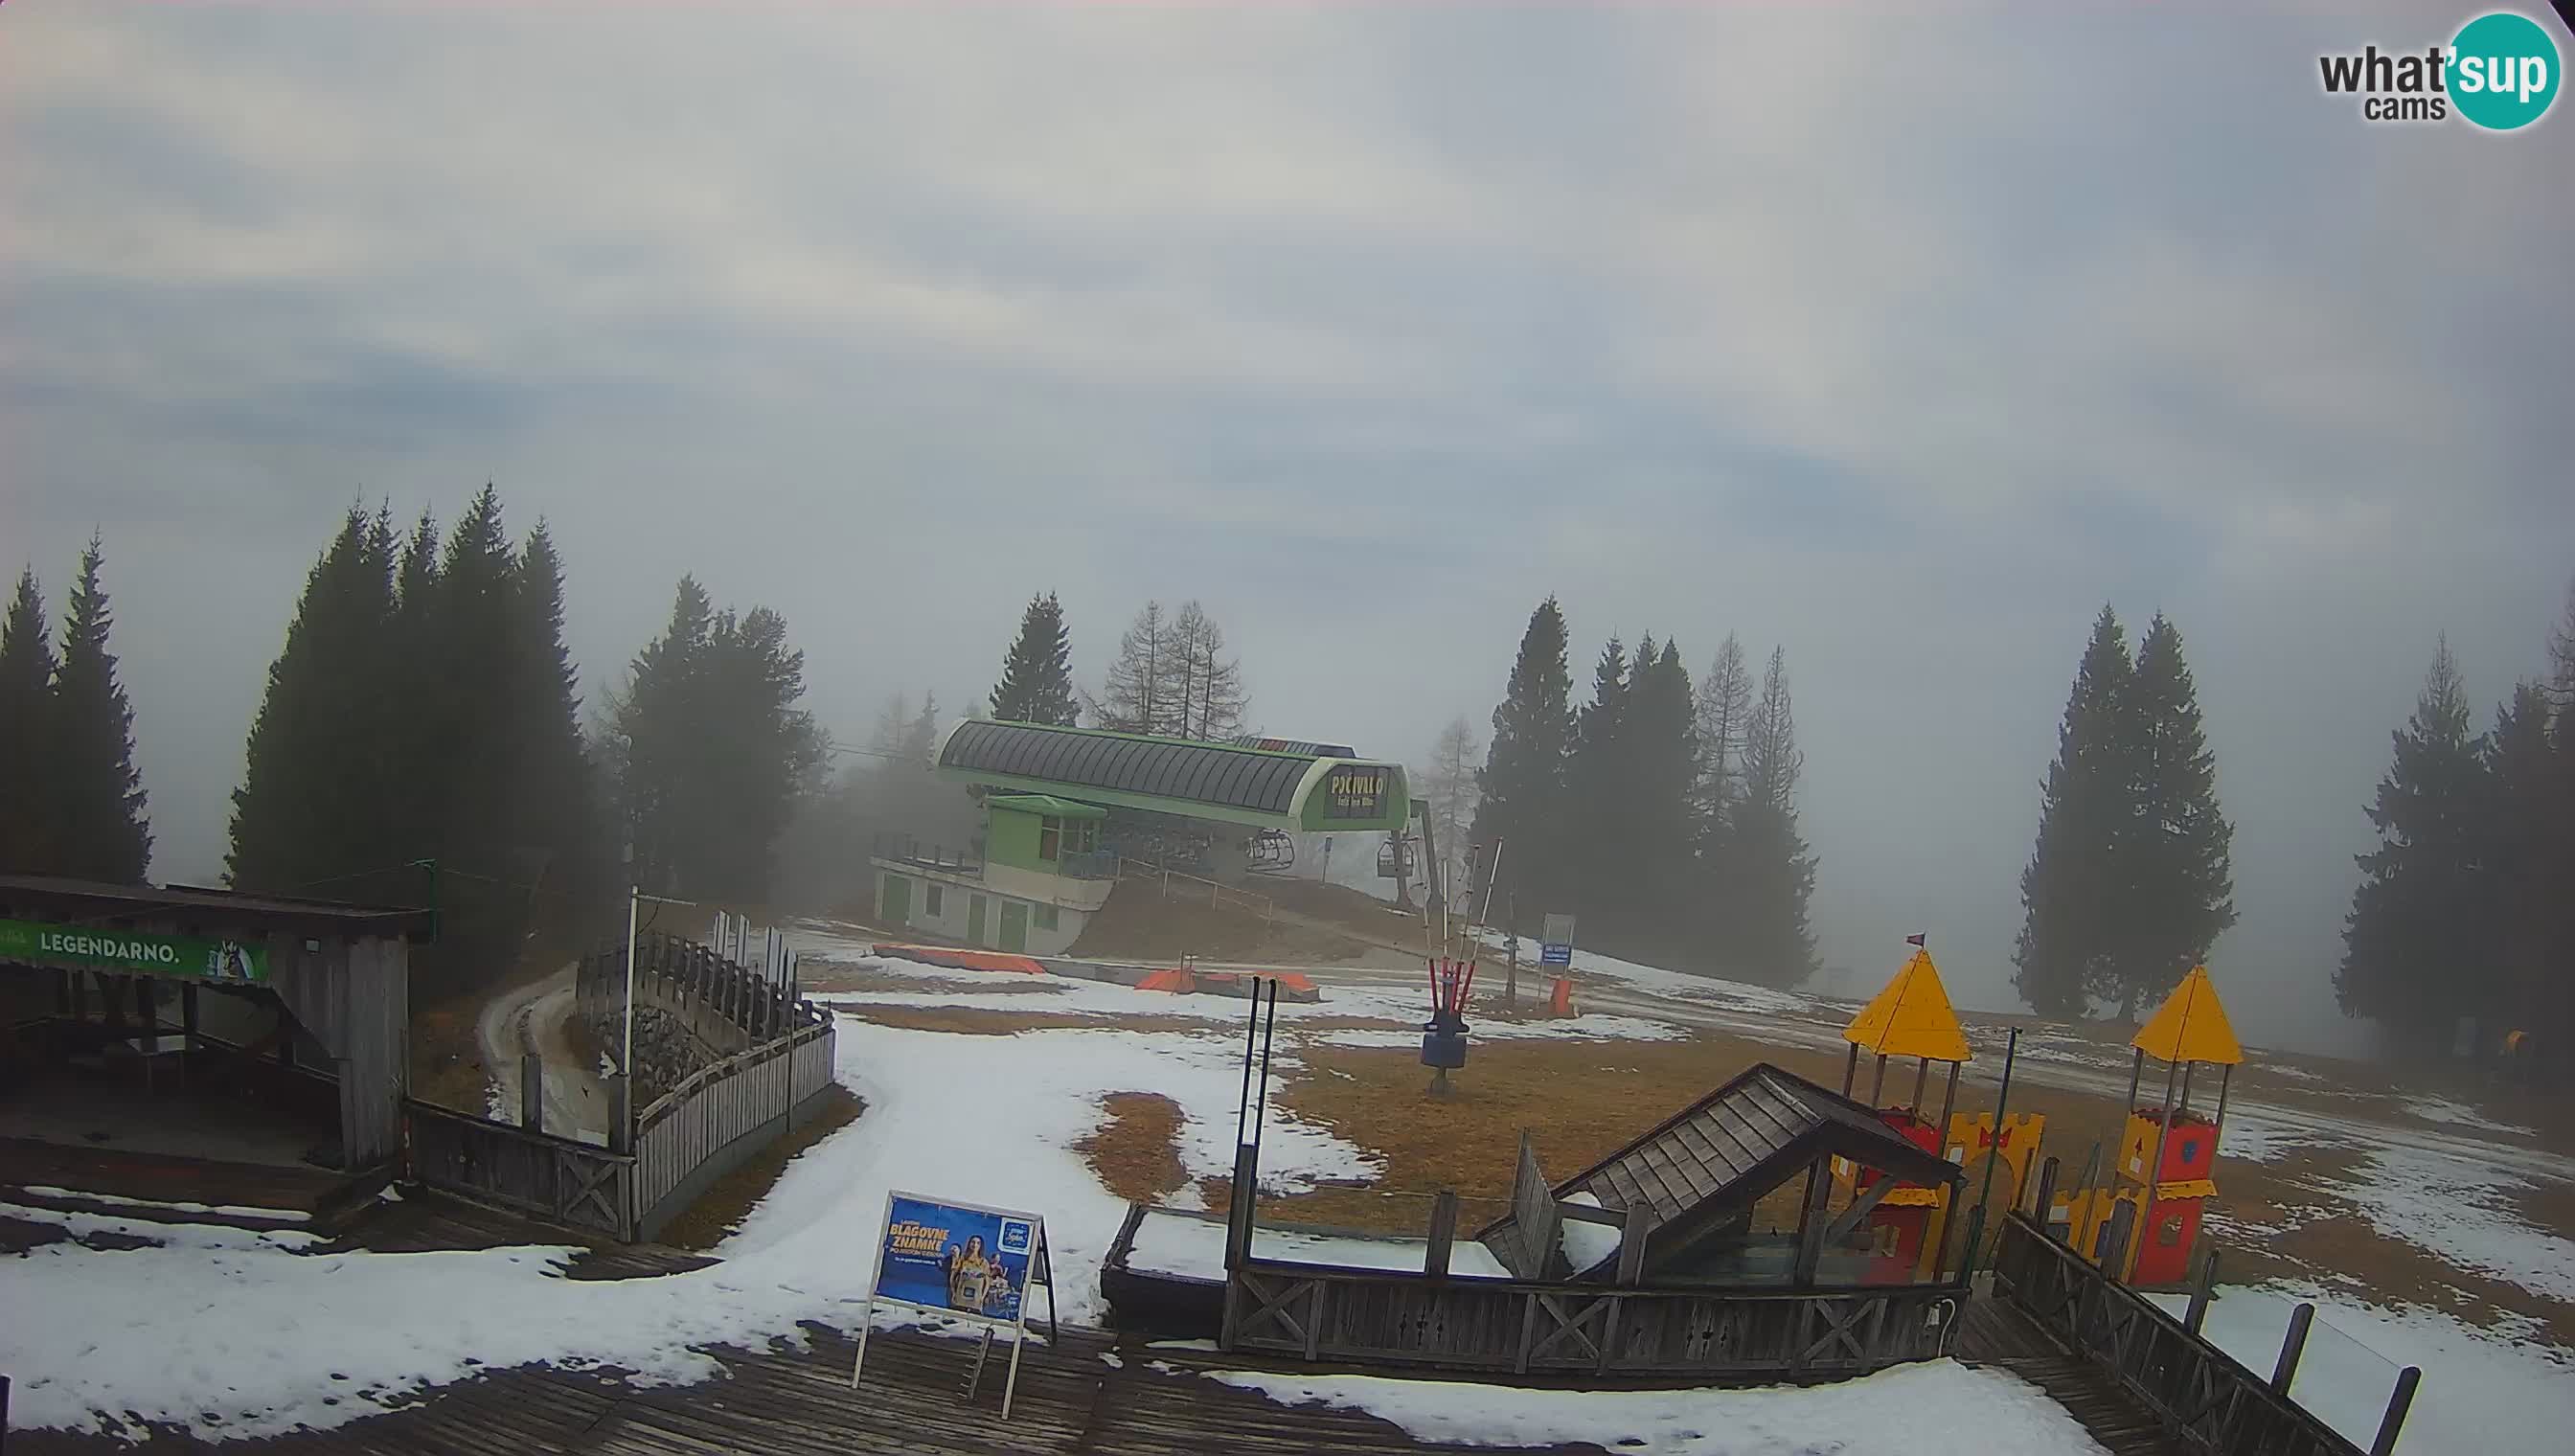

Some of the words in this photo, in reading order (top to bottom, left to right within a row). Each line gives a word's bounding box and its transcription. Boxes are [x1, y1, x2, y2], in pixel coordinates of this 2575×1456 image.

[41, 932, 180, 964] LEGENDARNO.
[890, 1223, 950, 1240] BLAGOVNE
[893, 1236, 944, 1252] ZNAMKE
